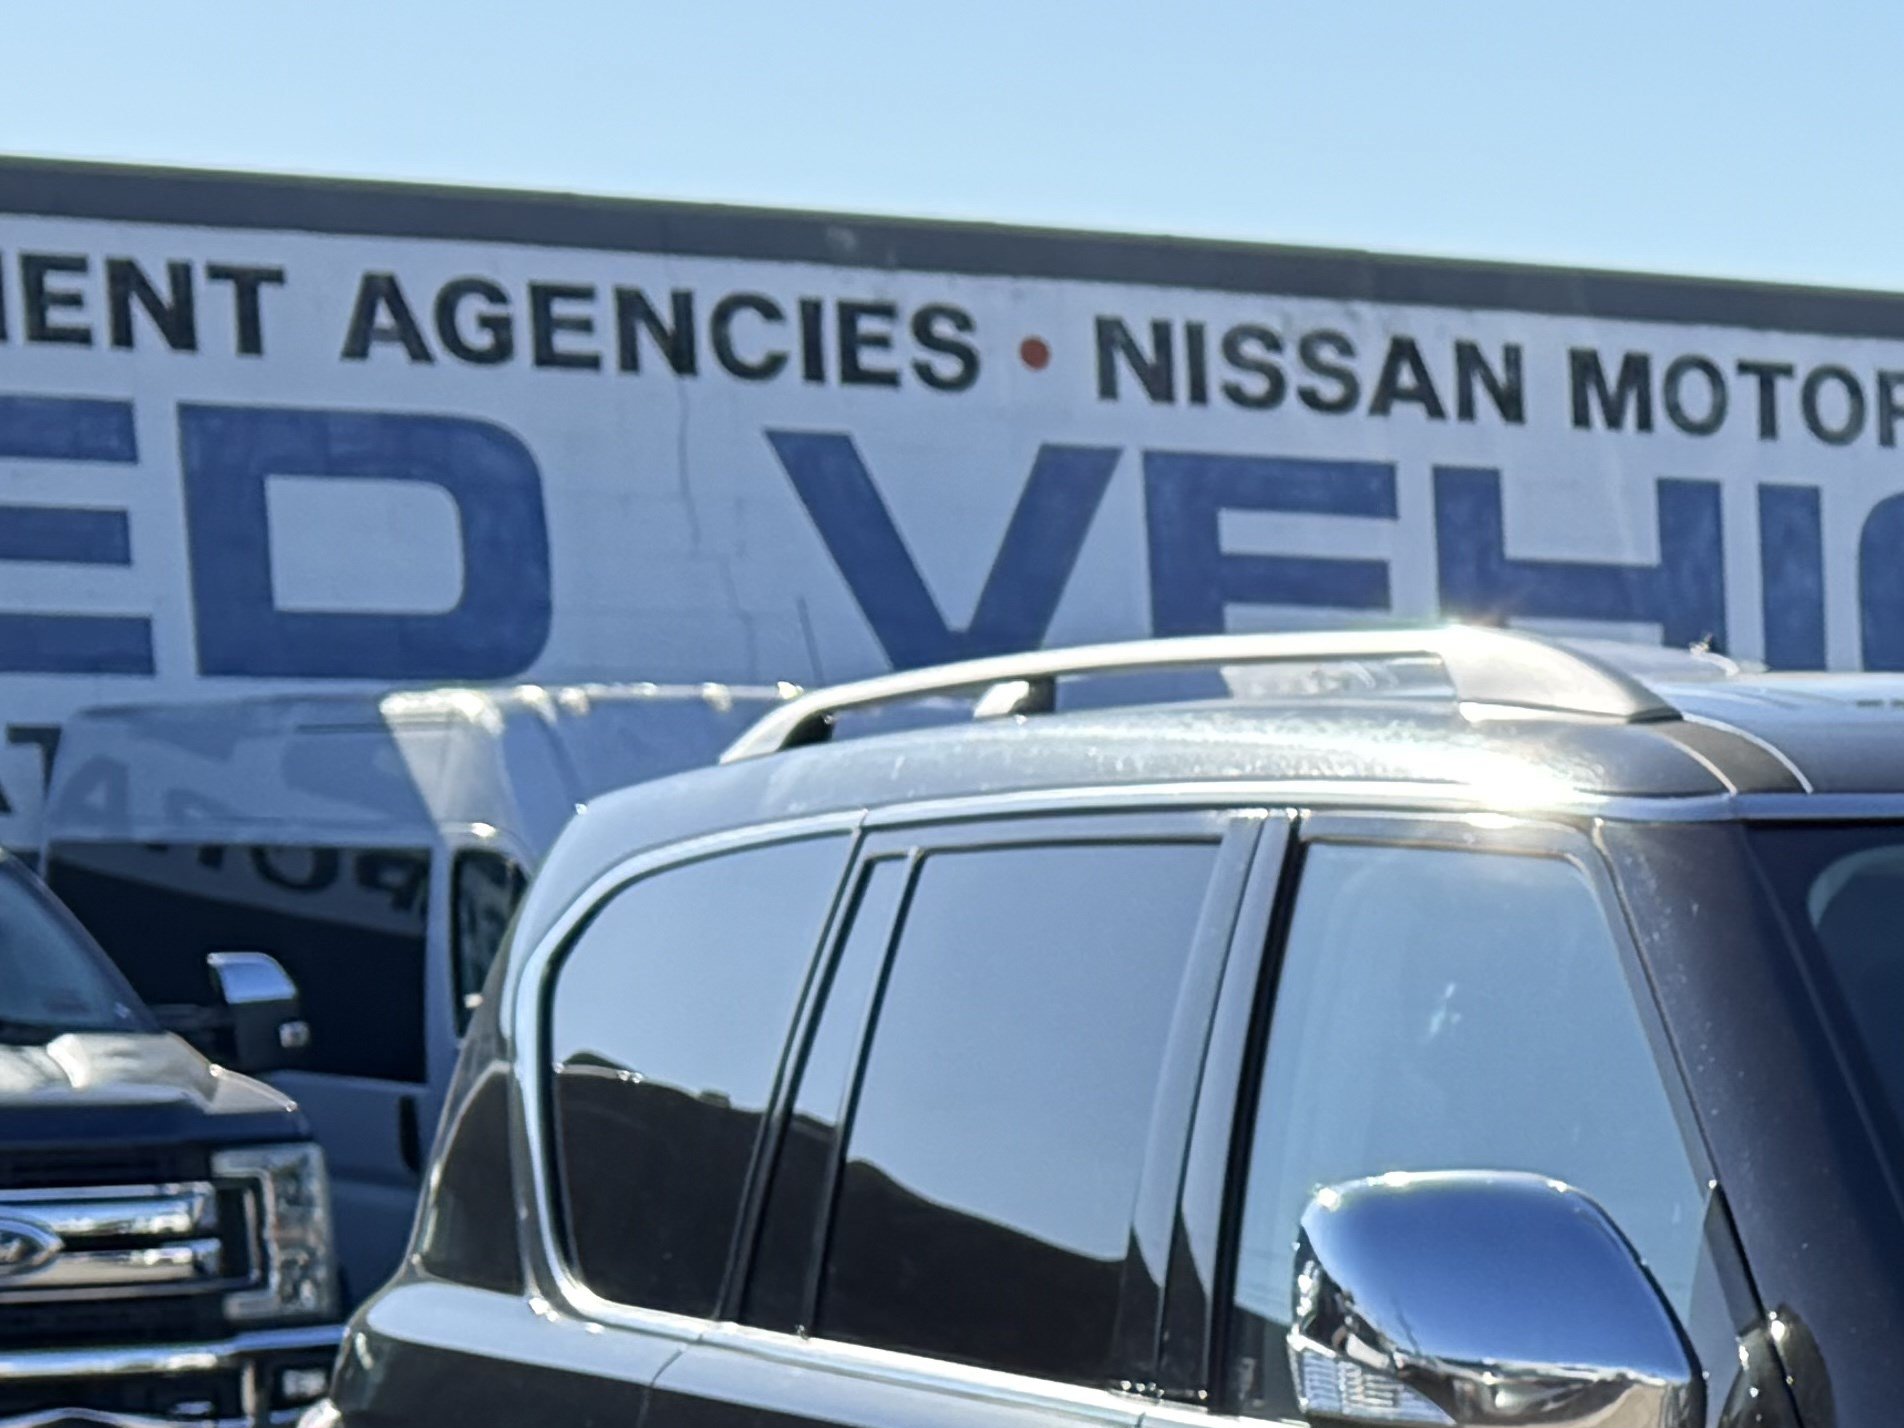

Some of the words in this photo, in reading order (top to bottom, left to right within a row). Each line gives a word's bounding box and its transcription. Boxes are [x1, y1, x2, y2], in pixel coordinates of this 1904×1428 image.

[0, 251, 286, 357] ENT
[340, 272, 981, 392] AGENCIES
[1094, 314, 1528, 427] NISSAN
